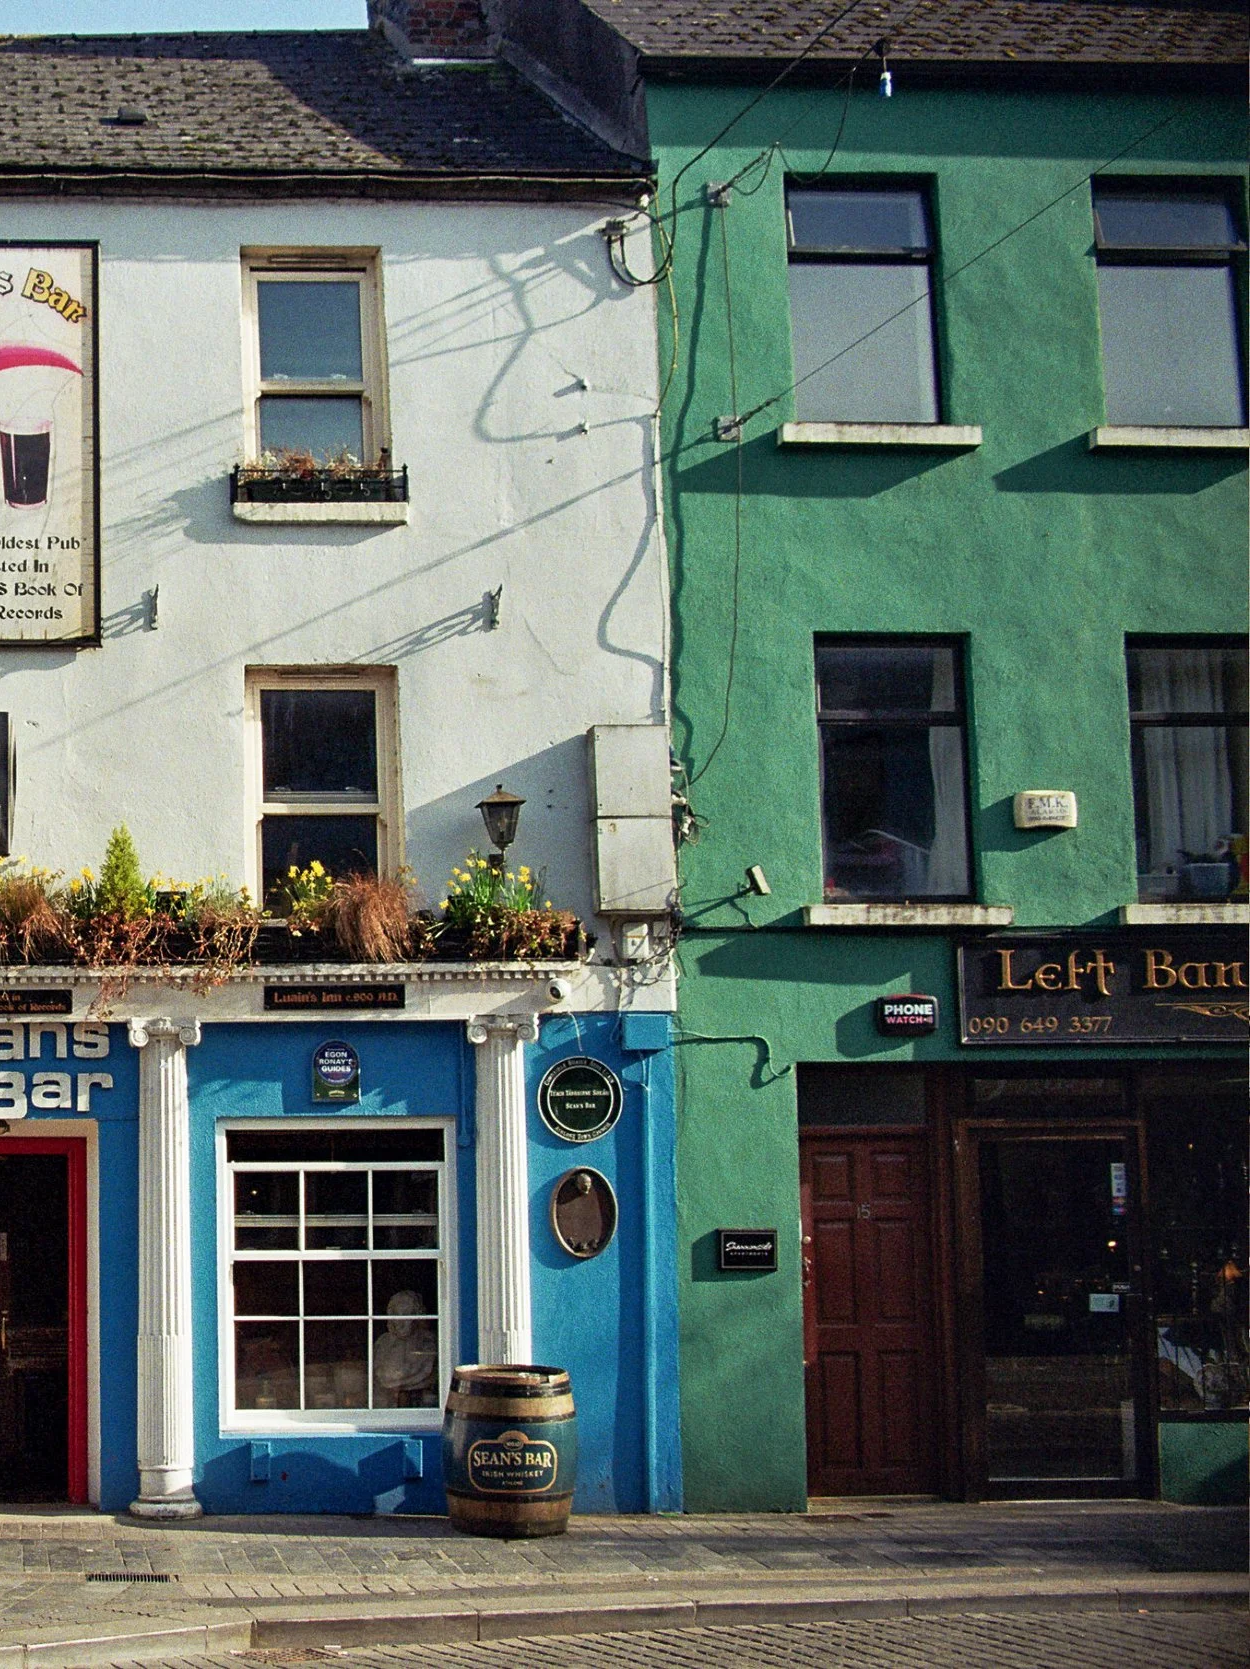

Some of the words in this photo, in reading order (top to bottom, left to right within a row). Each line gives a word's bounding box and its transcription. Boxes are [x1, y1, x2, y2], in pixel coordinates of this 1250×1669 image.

[21, 267, 87, 324] Bar
[47, 536, 80, 550] Pub
[34, 559, 49, 573] In
[14, 582, 57, 596] Book
[63, 582, 84, 596] Of
[996, 949, 1115, 996] Left
[273, 991, 318, 1003] Luain's
[322, 991, 342, 1003] Inn
[884, 1003, 933, 1015] PHONE
[885, 1015, 923, 1024] WATCH
[968, 1017, 1009, 1034] 090
[1020, 1017, 1058, 1034] 649
[1069, 1016, 1113, 1034] 3377
[321, 1065, 352, 1073] GUIDES
[857, 1203, 870, 1219] 15
[473, 1450, 522, 1468] SEAN'S
[525, 1451, 553, 1468] BAR
[481, 1469, 504, 1478] IRISH
[506, 1469, 544, 1478] WHISKEY
